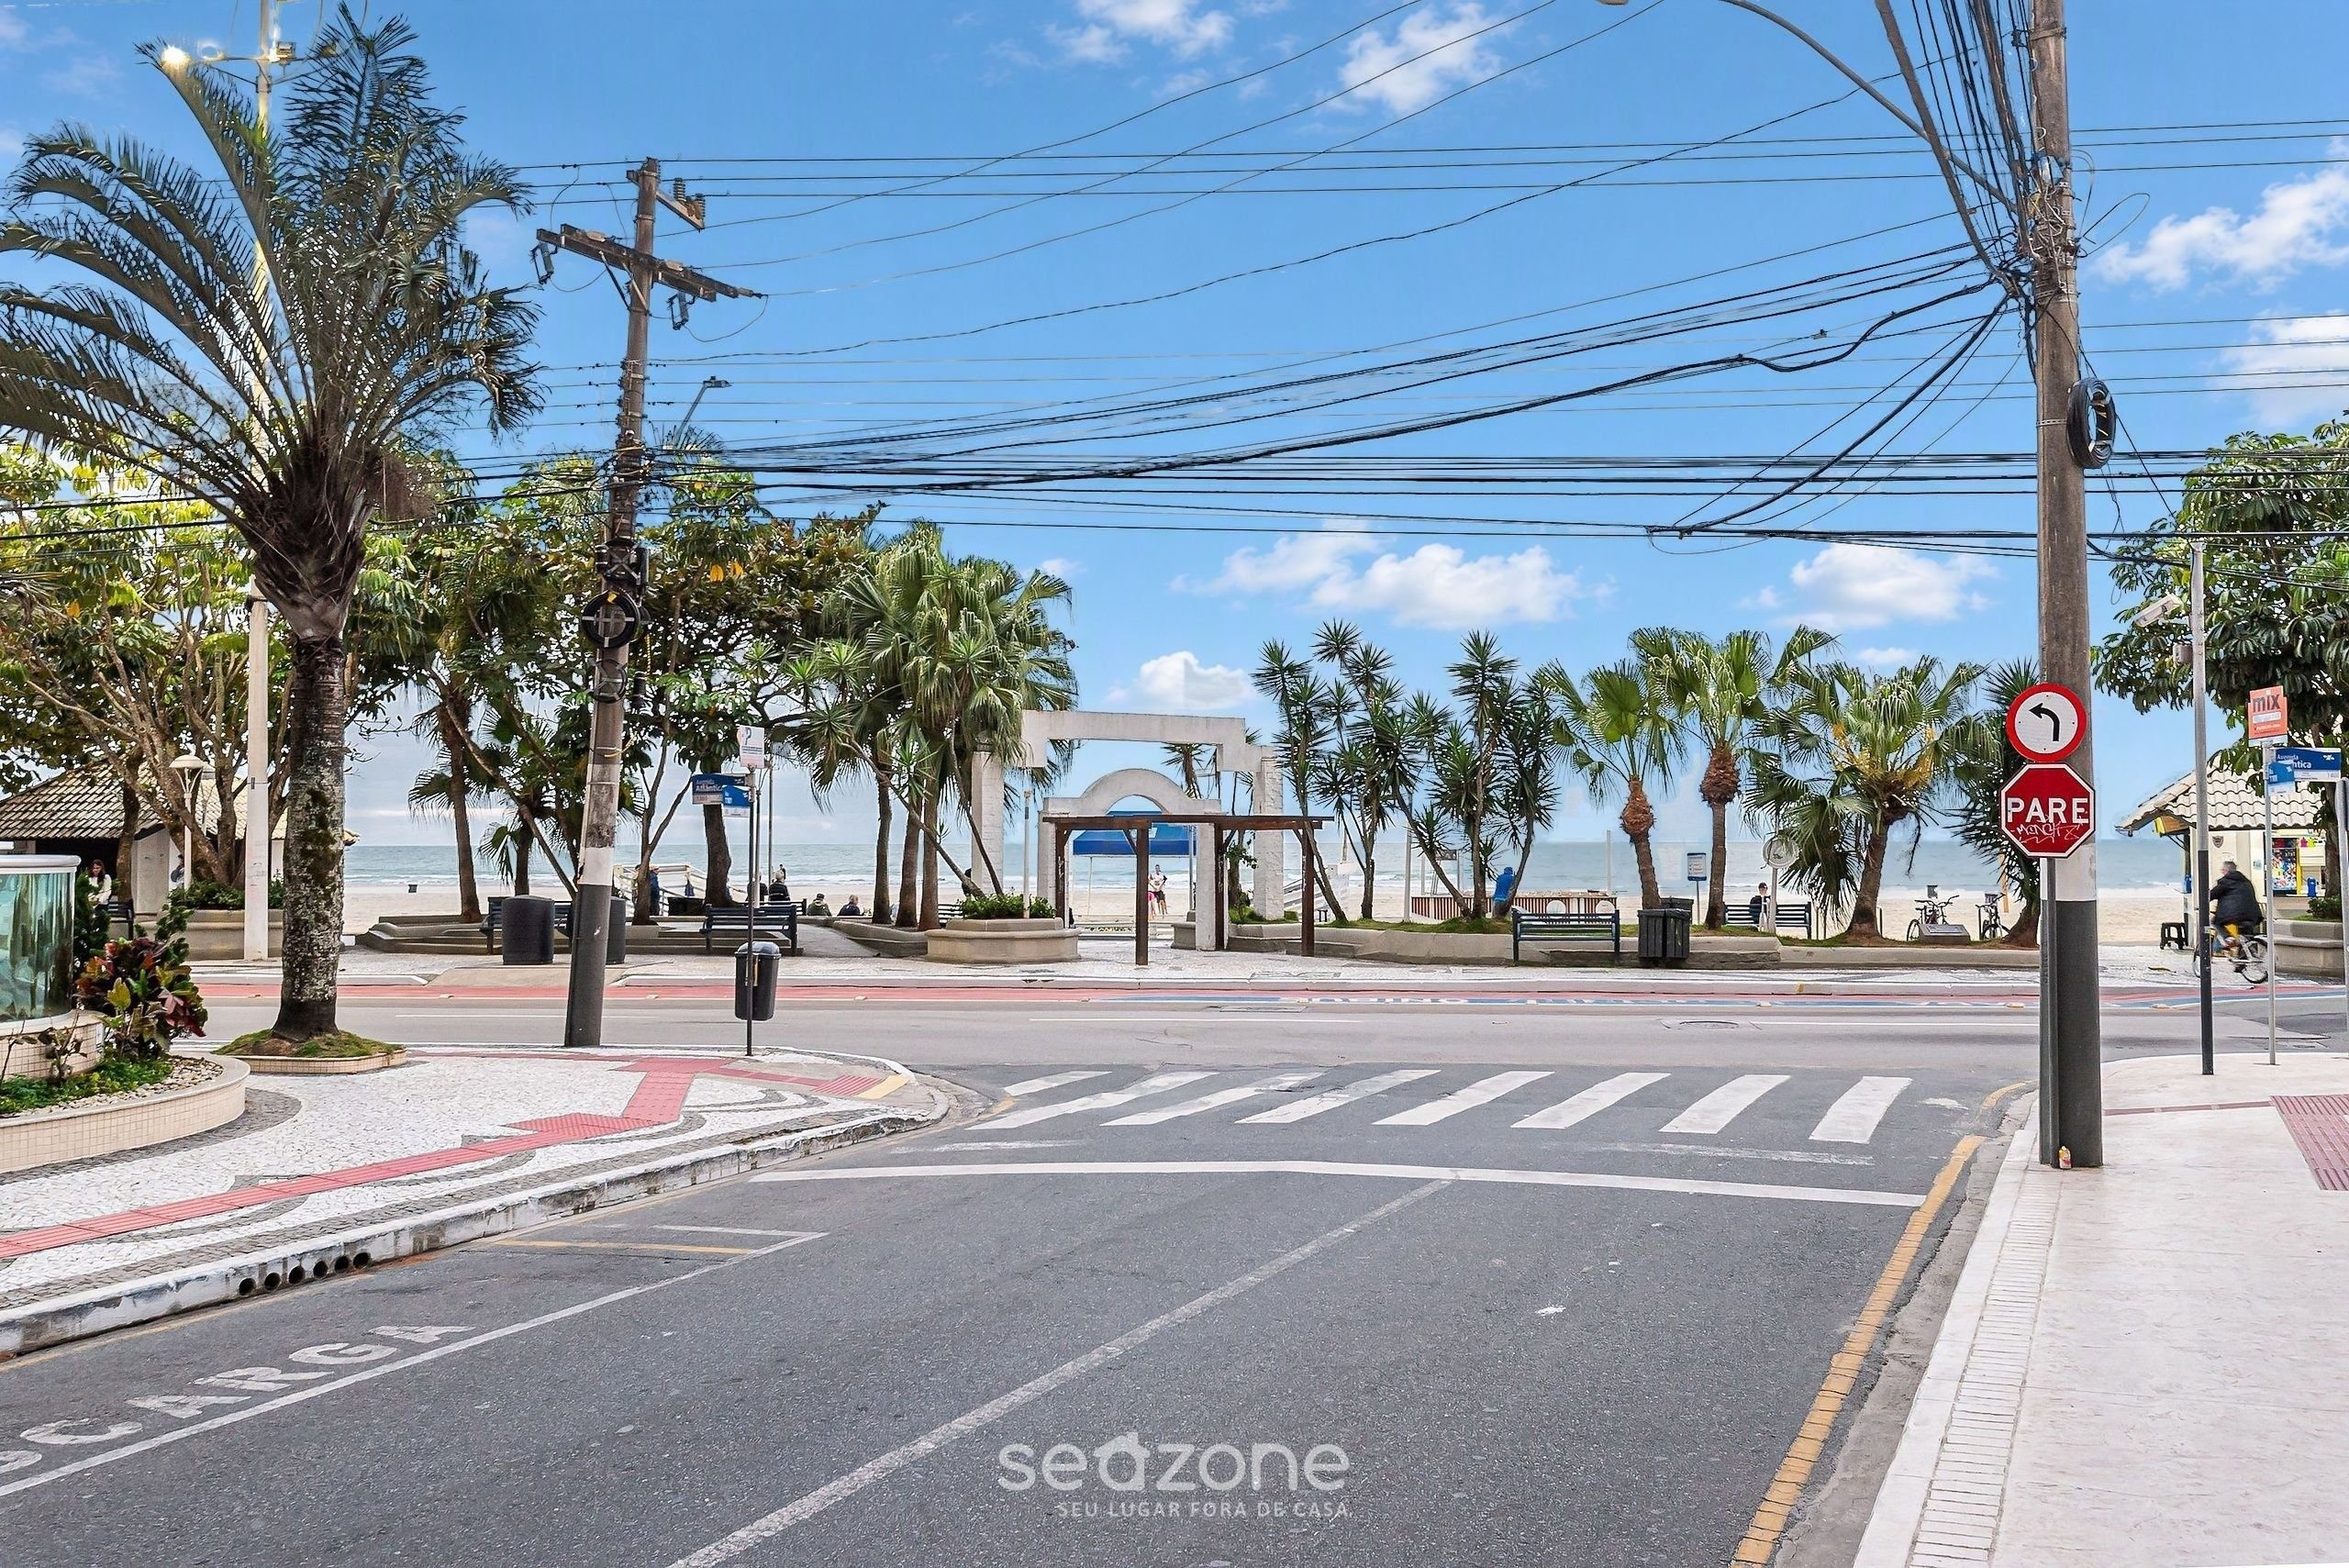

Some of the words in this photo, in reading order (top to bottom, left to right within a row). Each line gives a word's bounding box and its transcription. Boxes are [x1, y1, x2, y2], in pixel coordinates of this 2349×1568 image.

[2253, 690, 2281, 713] mix
[2292, 760, 2312, 769] ntica
[2007, 797, 2089, 824] PARE
